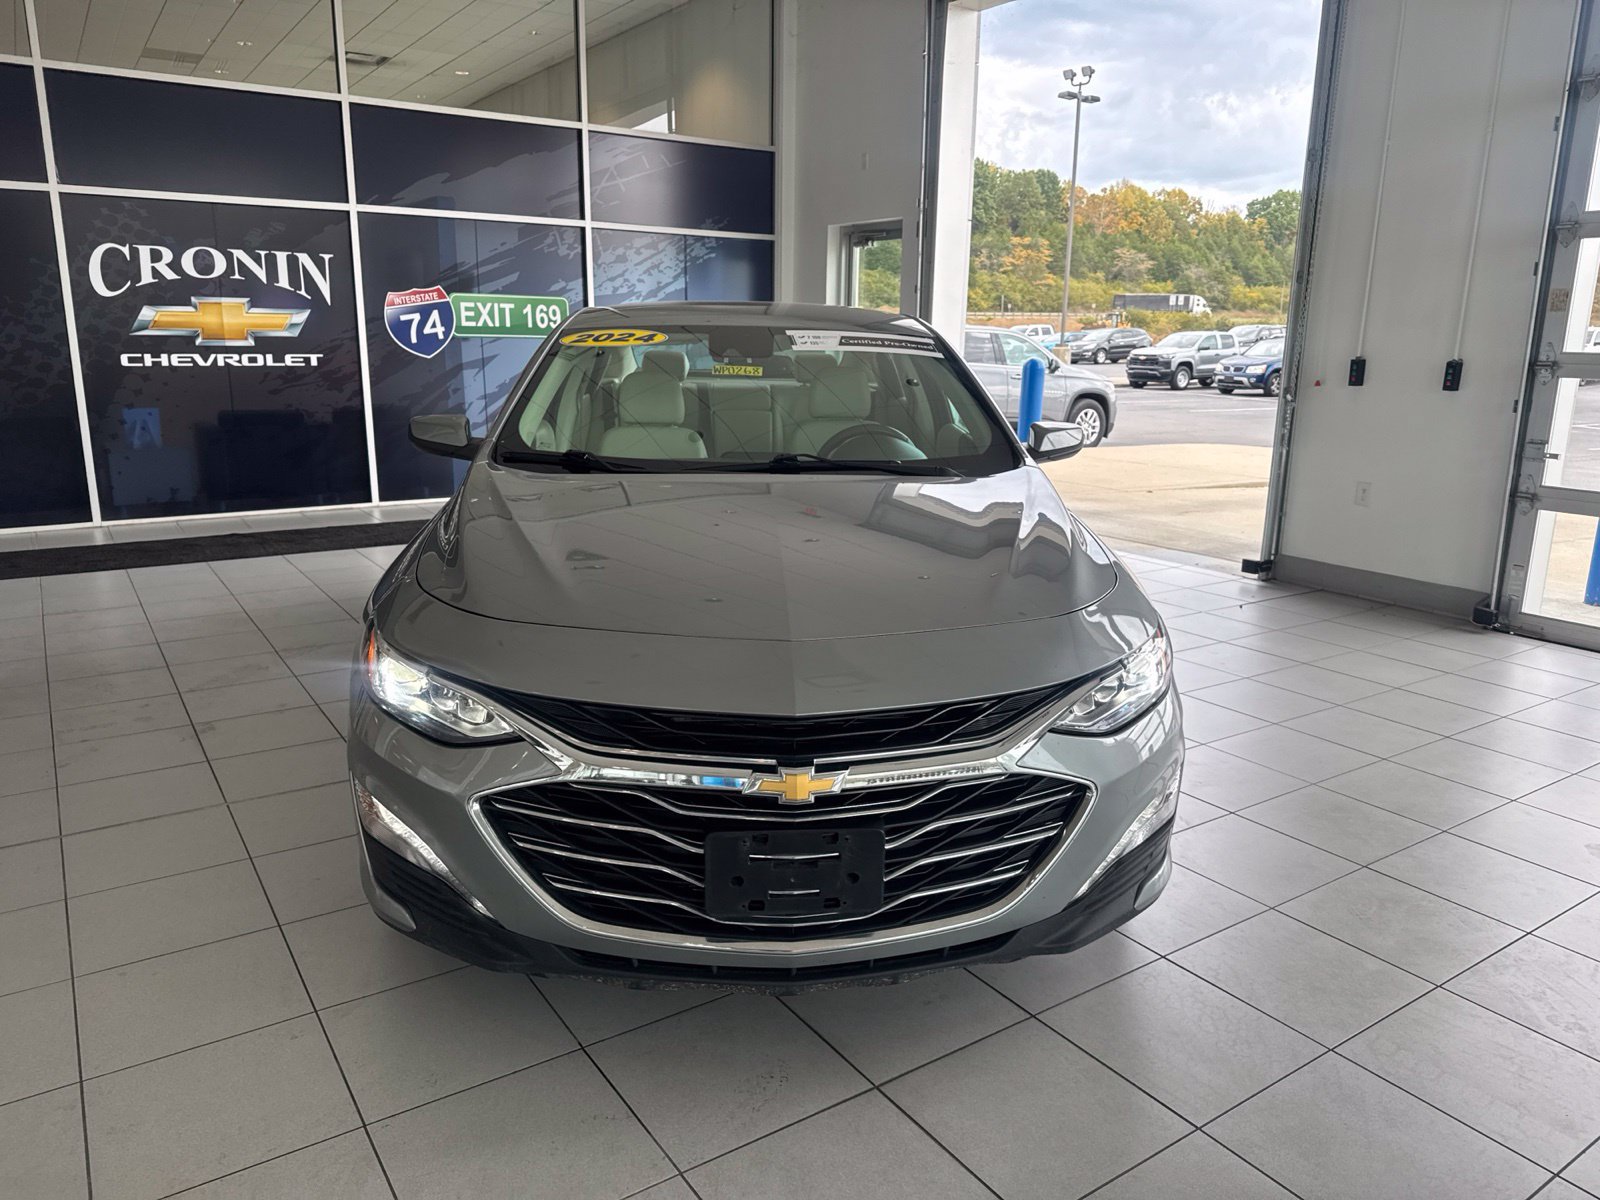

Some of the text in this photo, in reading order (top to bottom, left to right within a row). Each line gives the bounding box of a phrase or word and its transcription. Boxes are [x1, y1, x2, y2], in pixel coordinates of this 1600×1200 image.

[88, 242, 334, 306] CRONIN
[393, 291, 439, 305] INTERSTATE
[459, 302, 562, 329] EXIT 169
[400, 309, 446, 344] 74
[568, 332, 658, 344] 2024
[841, 338, 934, 350] Certified Pre-Owned
[120, 353, 324, 367] CHEVROLET
